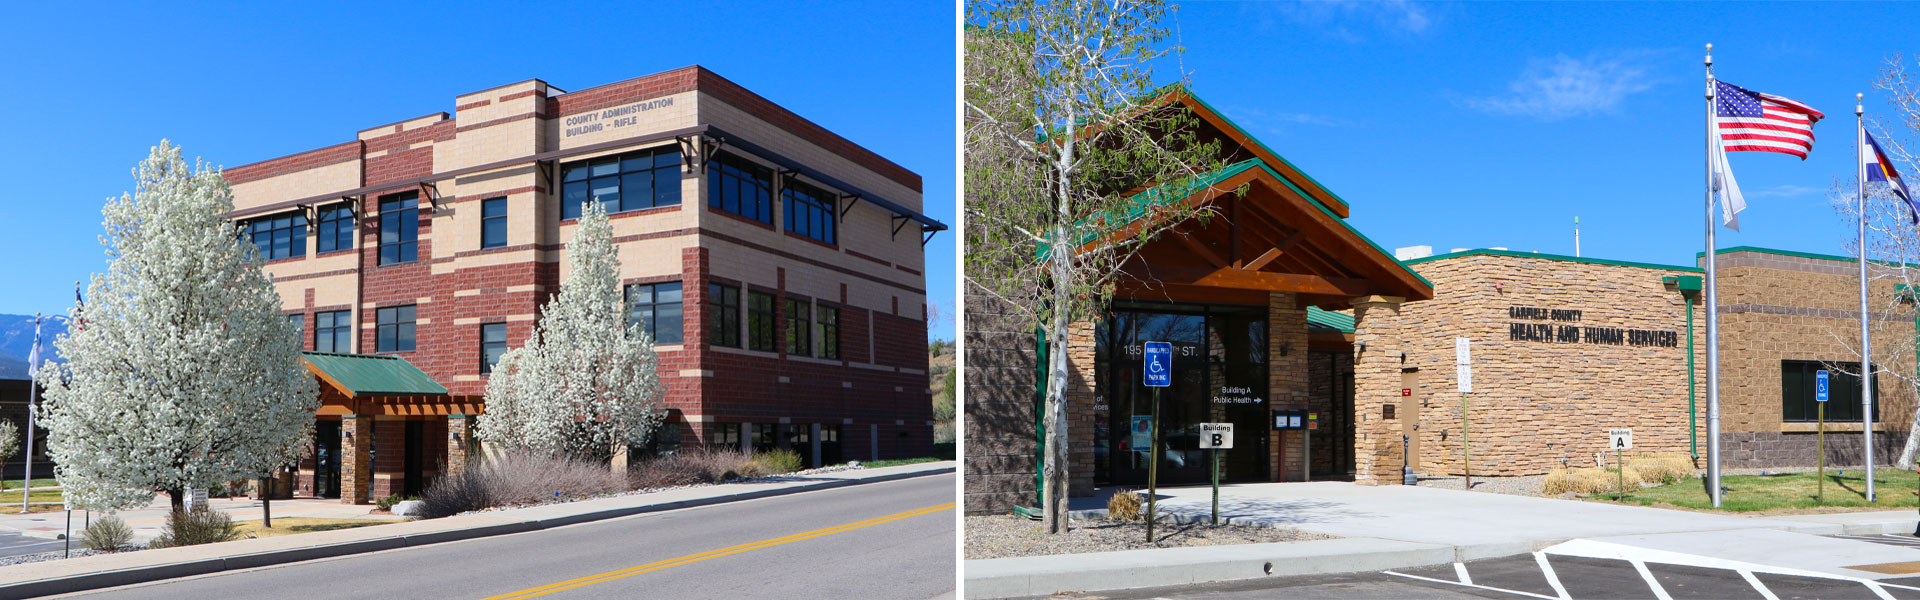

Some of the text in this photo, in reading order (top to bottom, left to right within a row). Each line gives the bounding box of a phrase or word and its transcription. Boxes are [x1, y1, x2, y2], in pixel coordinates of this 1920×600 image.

[566, 97, 674, 126] COUNTY ADMINISTRATION
[566, 123, 603, 137] BUILDING
[614, 116, 637, 128] RIFLE
[1509, 306, 1582, 321] GARFIELD COUNTY
[1510, 322, 1678, 347] HEALTH AND HUMAN SERVICES
[1123, 345, 1142, 355] 195
[1182, 346, 1198, 356] ST.
[1222, 386, 1246, 395] Building
[1203, 424, 1231, 432] Building
[1212, 433, 1223, 447] B
[1617, 437, 1624, 447] A
